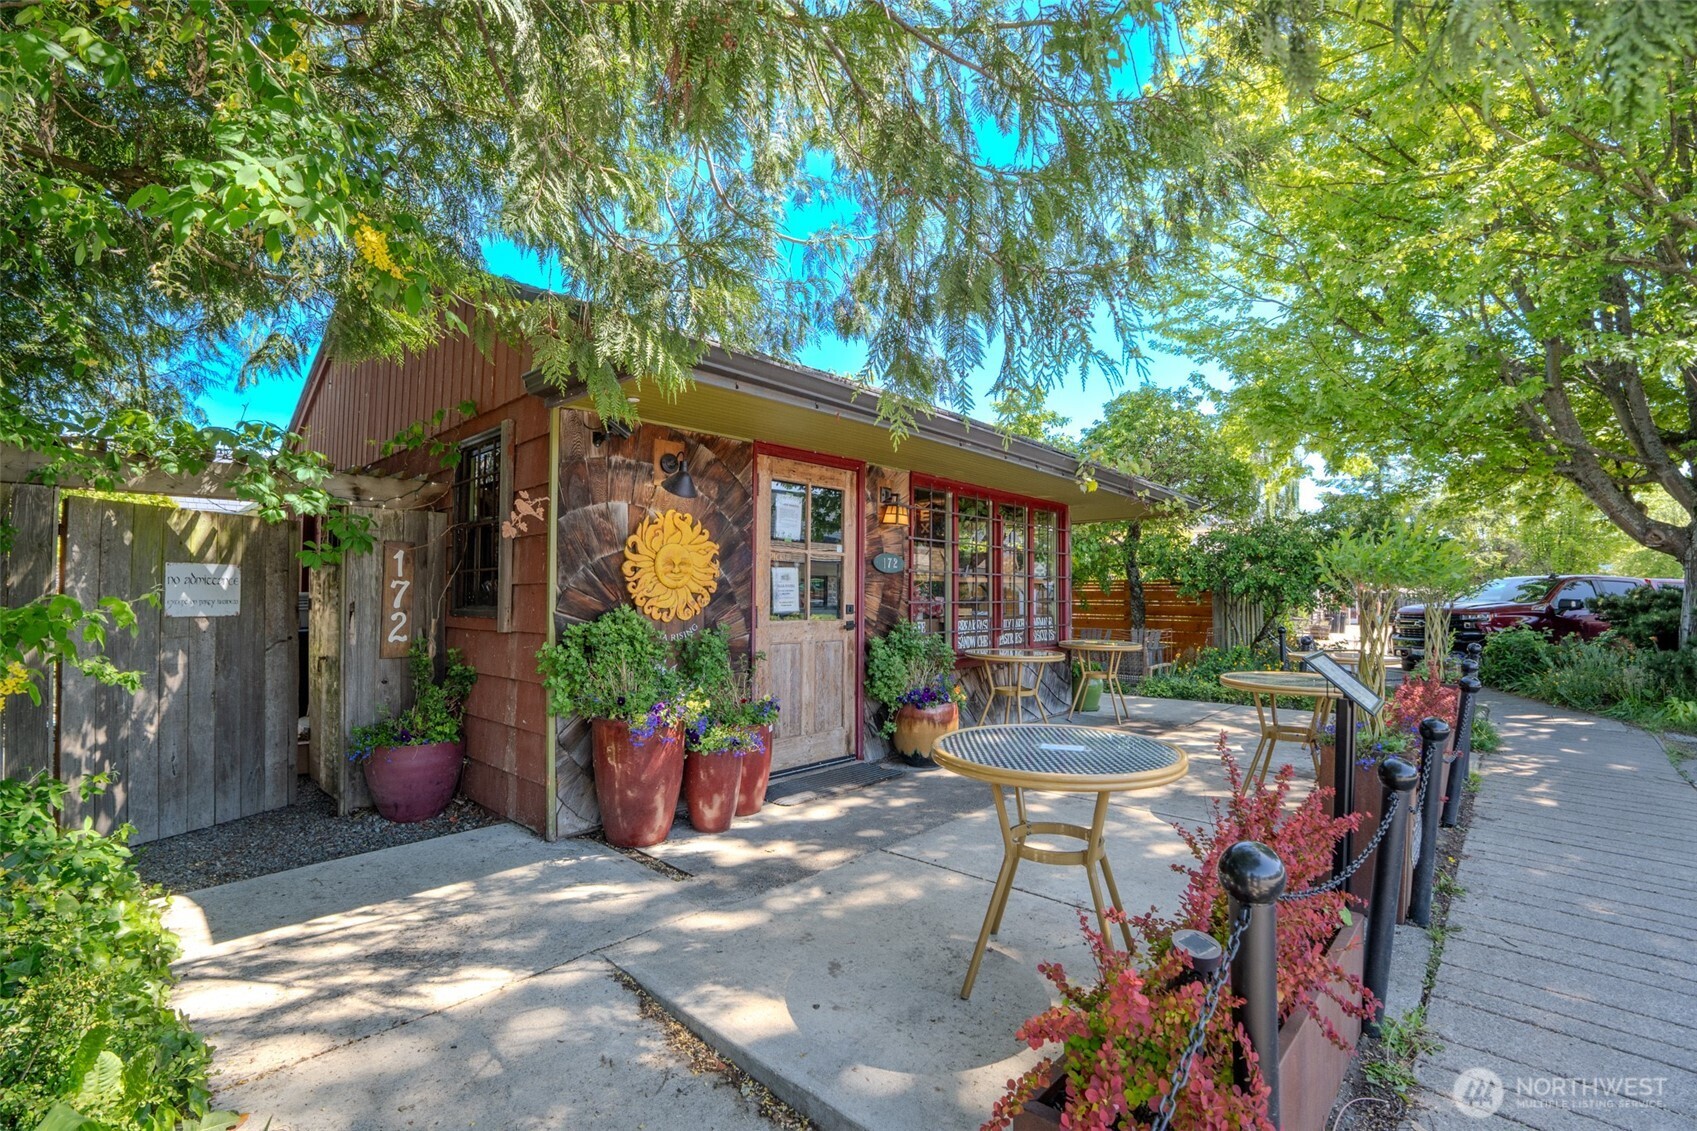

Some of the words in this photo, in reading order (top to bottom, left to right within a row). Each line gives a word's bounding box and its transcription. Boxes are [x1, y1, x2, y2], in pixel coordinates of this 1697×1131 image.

[883, 557, 898, 568] 172
[388, 550, 410, 643] 172
[958, 619, 989, 634] BREAKFAS
